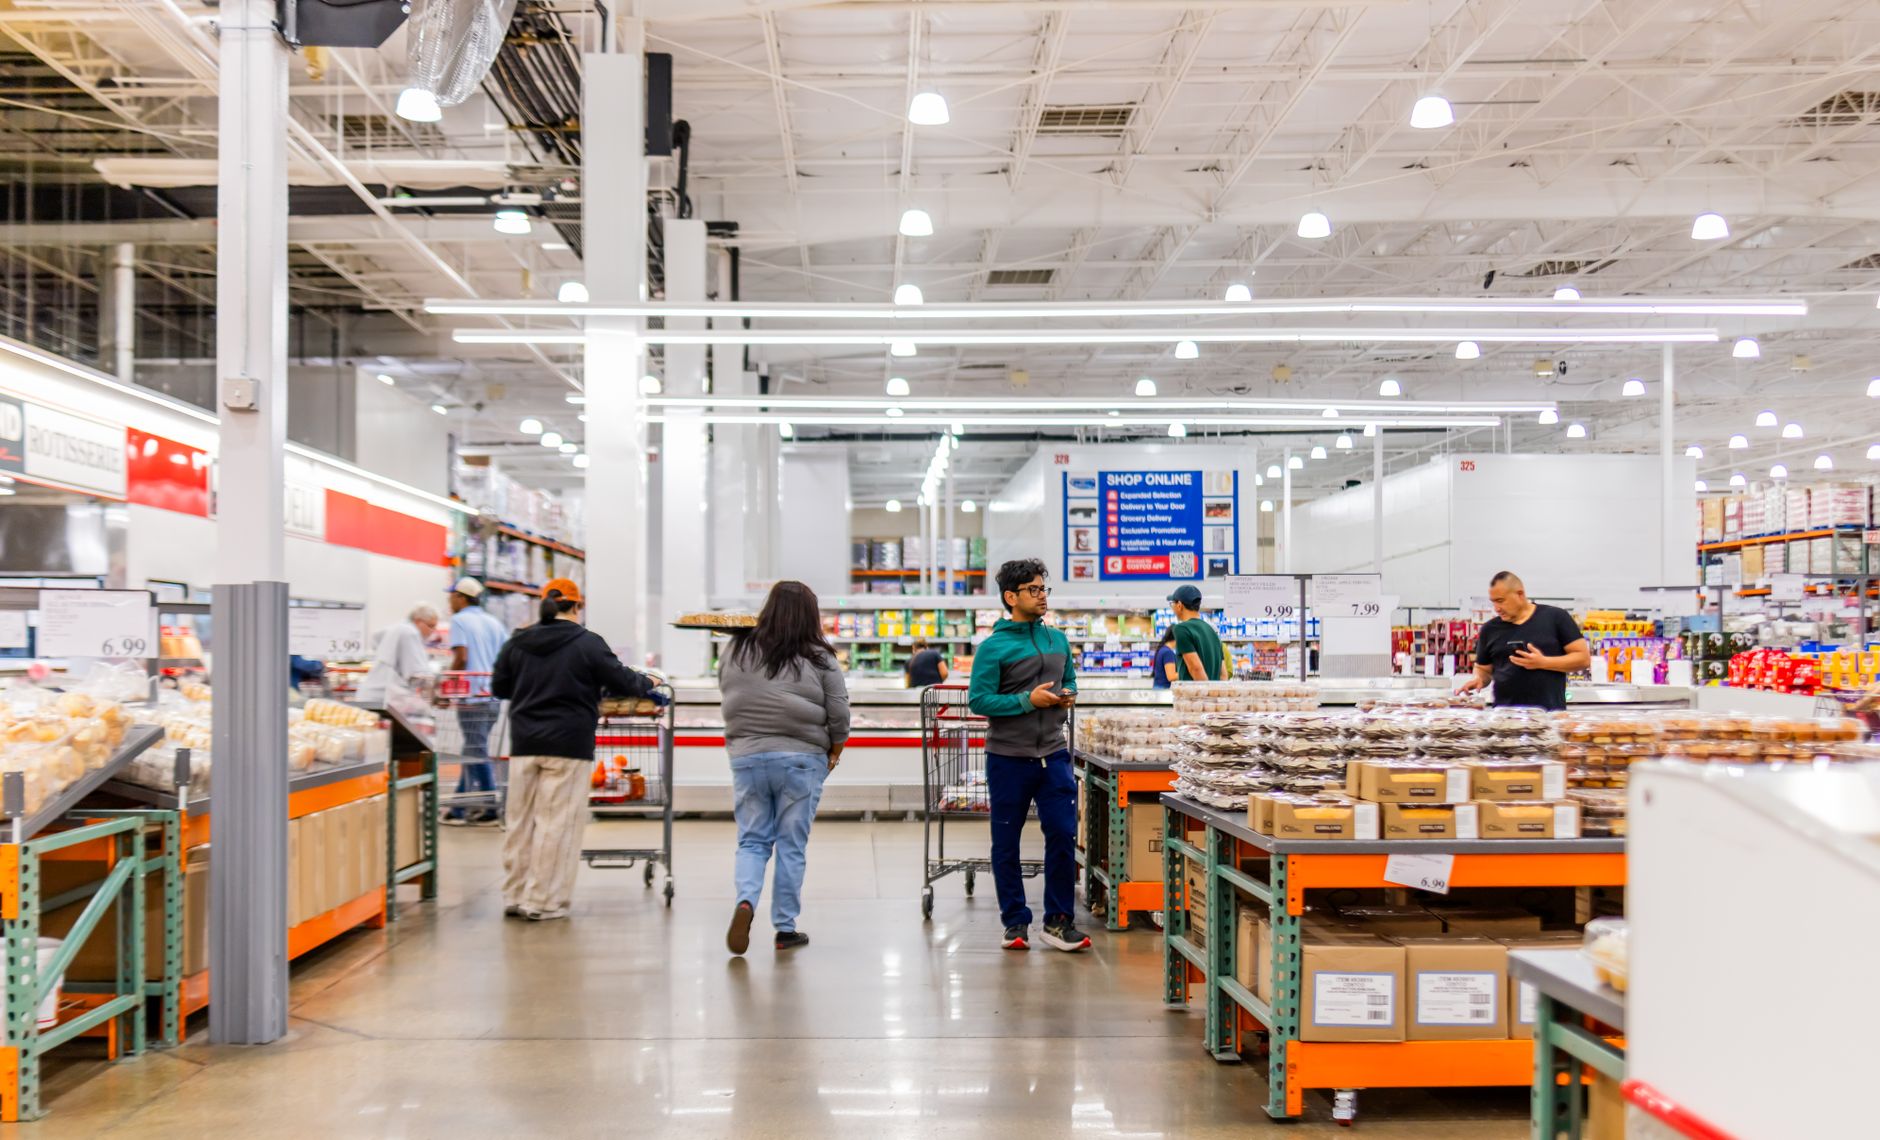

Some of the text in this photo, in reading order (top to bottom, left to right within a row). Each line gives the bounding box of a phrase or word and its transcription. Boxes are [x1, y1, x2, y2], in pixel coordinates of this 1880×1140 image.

[28, 424, 121, 474] ROTISSERIE
[1460, 460, 1475, 471] 325
[1107, 473, 1192, 485] SHOP ONLINE
[1120, 491, 1181, 500] Expanded Selection
[1120, 503, 1145, 511] Delivery
[1120, 515, 1172, 523] Grocery Delivery
[1120, 527, 1150, 535] Exclusive
[1120, 539, 1154, 547] Installation
[1177, 539, 1195, 547] Away
[1264, 605, 1293, 617] 9.99
[1351, 603, 1380, 616] 7.99
[102, 638, 146, 656] 6.99
[328, 640, 361, 653] 3.99
[1420, 877, 1446, 889] 6.99
